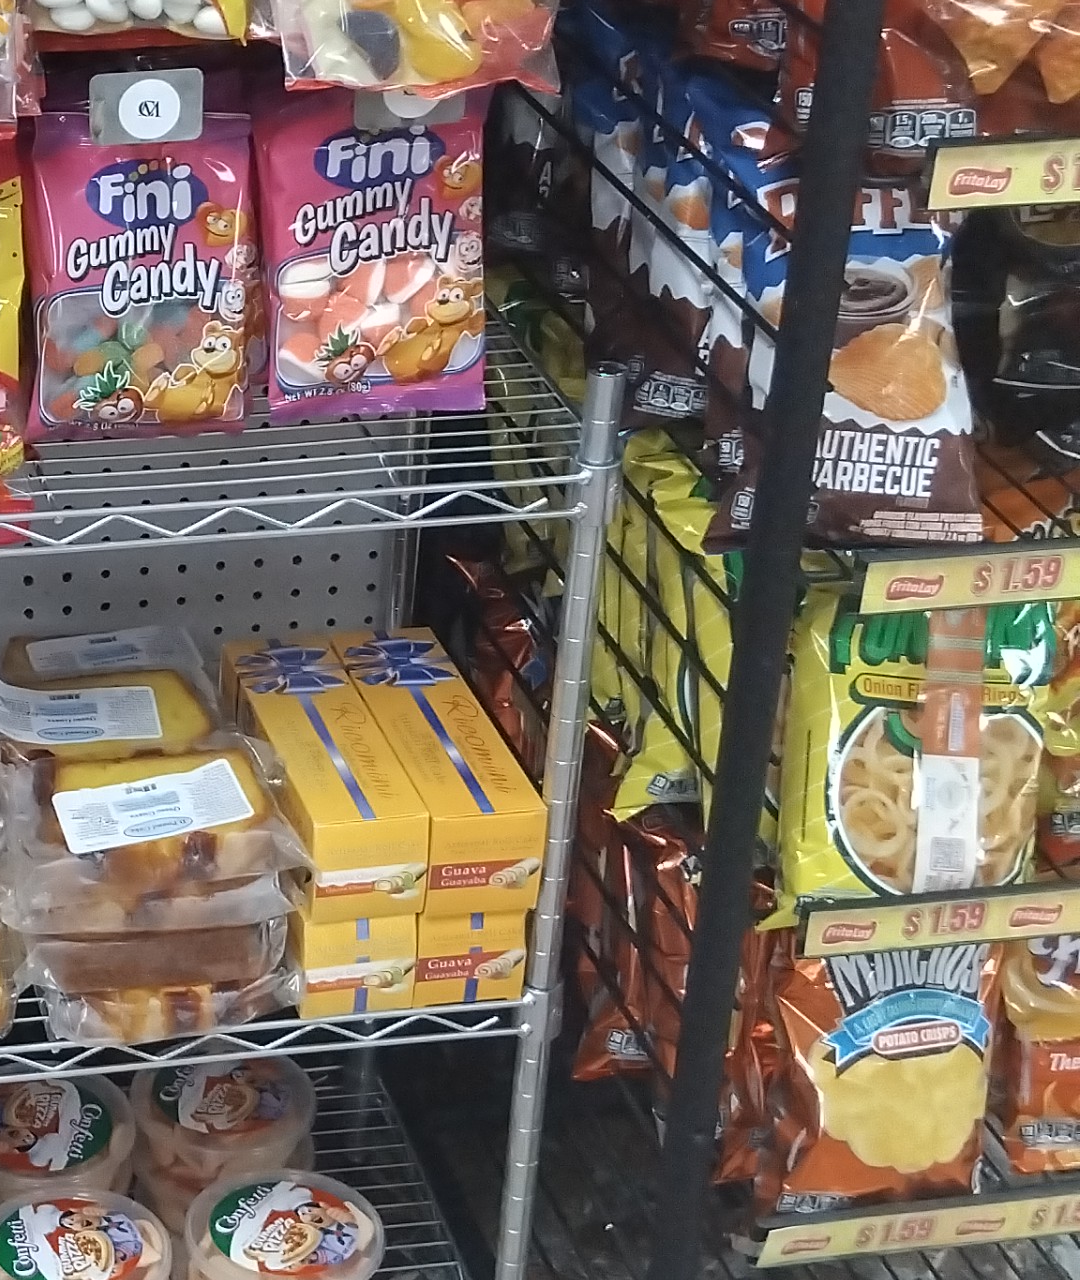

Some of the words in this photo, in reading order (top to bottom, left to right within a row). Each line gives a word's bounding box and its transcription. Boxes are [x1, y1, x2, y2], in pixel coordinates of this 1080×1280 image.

[326, 123, 433, 182] Fini
[98, 164, 194, 223] Fini
[953, 172, 1008, 192] FritoLay
[293, 177, 414, 247] Gummy
[66, 223, 176, 282] Gummy
[329, 199, 455, 278] Candy
[101, 244, 222, 317] Candy
[816, 429, 941, 468] UTHENTIC
[813, 460, 935, 498] ARBECUE
[971, 559, 994, 597] $
[1000, 554, 1065, 594] 1.59
[863, 677, 903, 698] Onion
[440, 864, 487, 877] Guava
[440, 876, 487, 888] Guayaba
[902, 906, 923, 942] $
[929, 900, 988, 935] 1.59
[424, 969, 470, 982] Guayaba
[427, 957, 473, 970] Guava
[877, 1030, 919, 1049] POTATO
[920, 1024, 957, 1044] CRISPS
[67, 1102, 104, 1160] Confetti
[214, 1183, 273, 1236] Confetti
[12, 1218, 41, 1277] Confetti
[64, 1232, 92, 1273] PIZZA
[263, 1217, 296, 1253] PIZZA
[879, 1220, 936, 1244] 1.59
